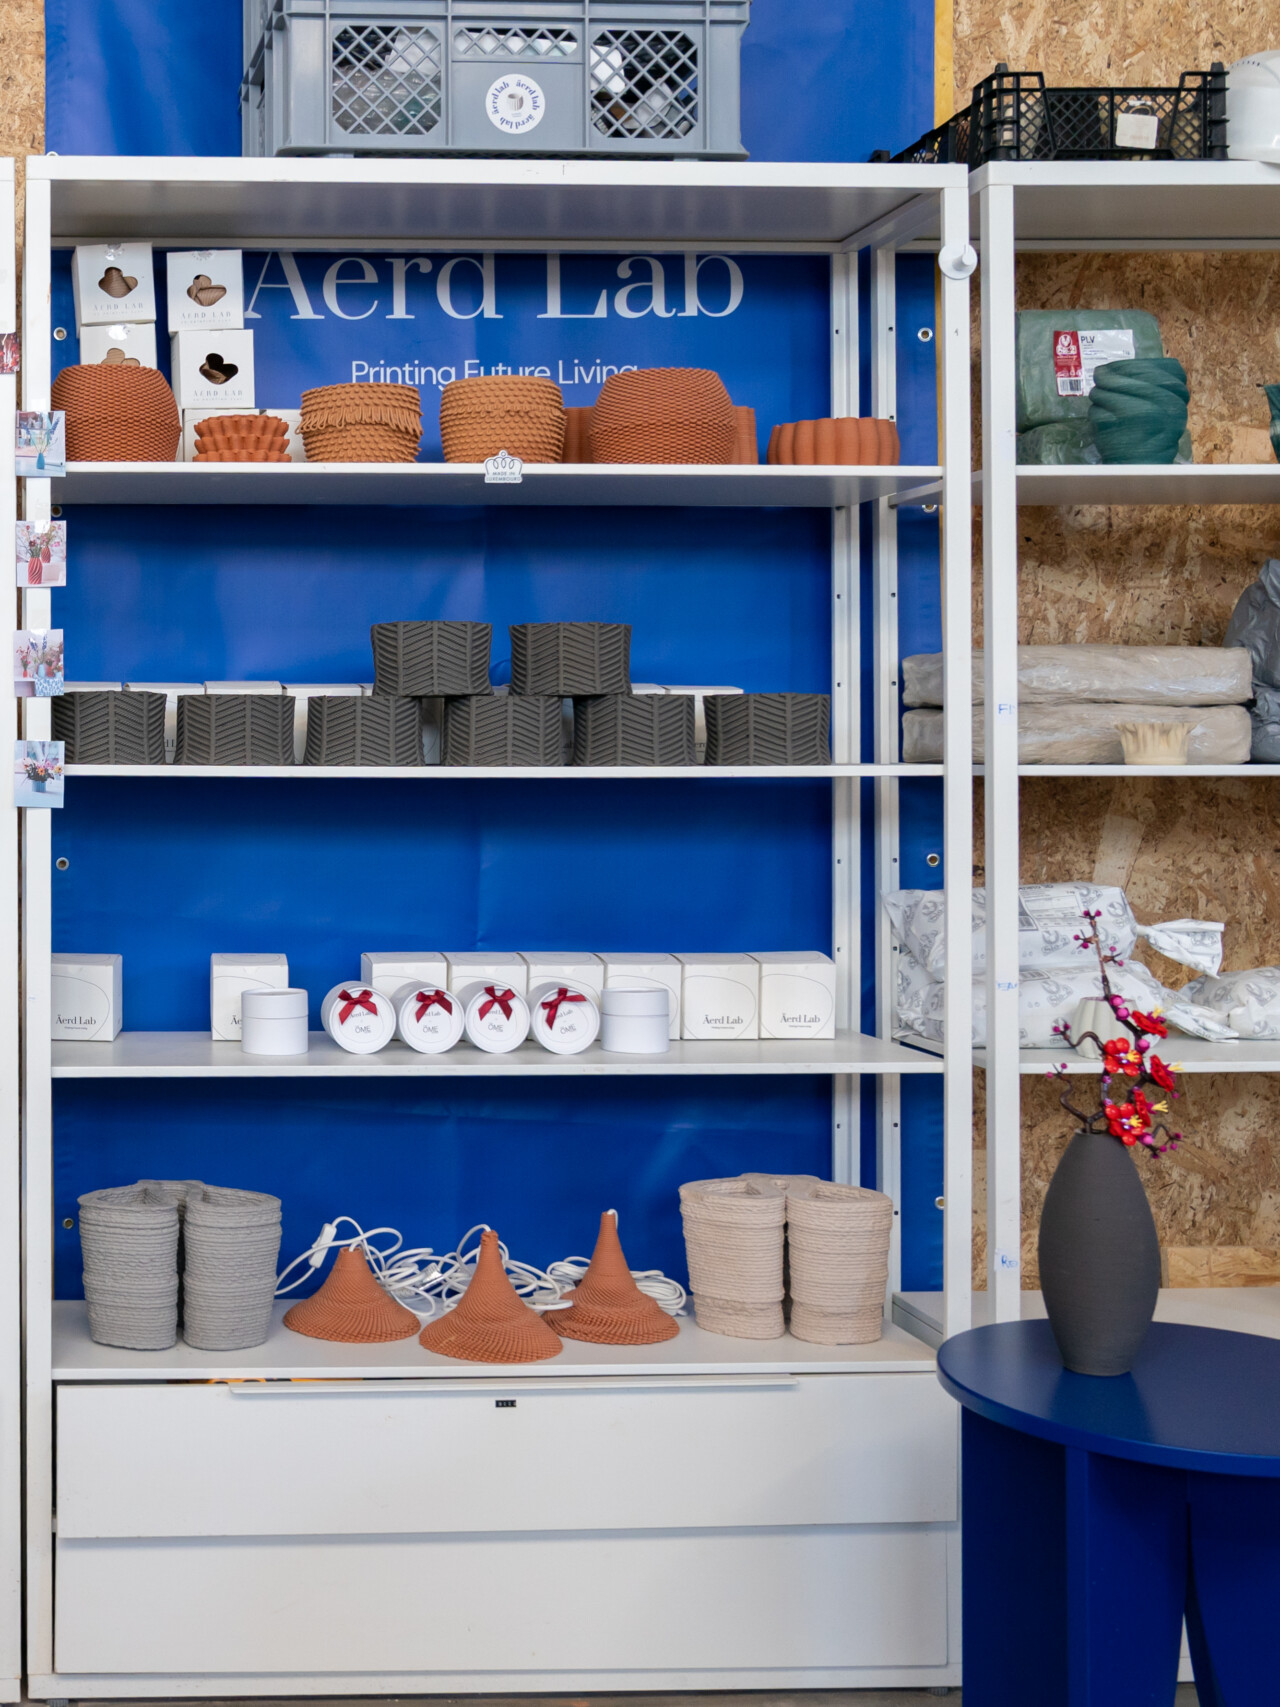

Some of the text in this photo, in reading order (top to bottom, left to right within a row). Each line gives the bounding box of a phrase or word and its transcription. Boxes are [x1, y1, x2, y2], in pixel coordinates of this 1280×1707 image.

[536, 252, 744, 319] Lab
[1081, 336, 1095, 344] PLV
[351, 359, 456, 391] Printing
[79, 1016, 97, 1025] Lab
[726, 1015, 744, 1025] Lab
[803, 1014, 821, 1023] Lab
